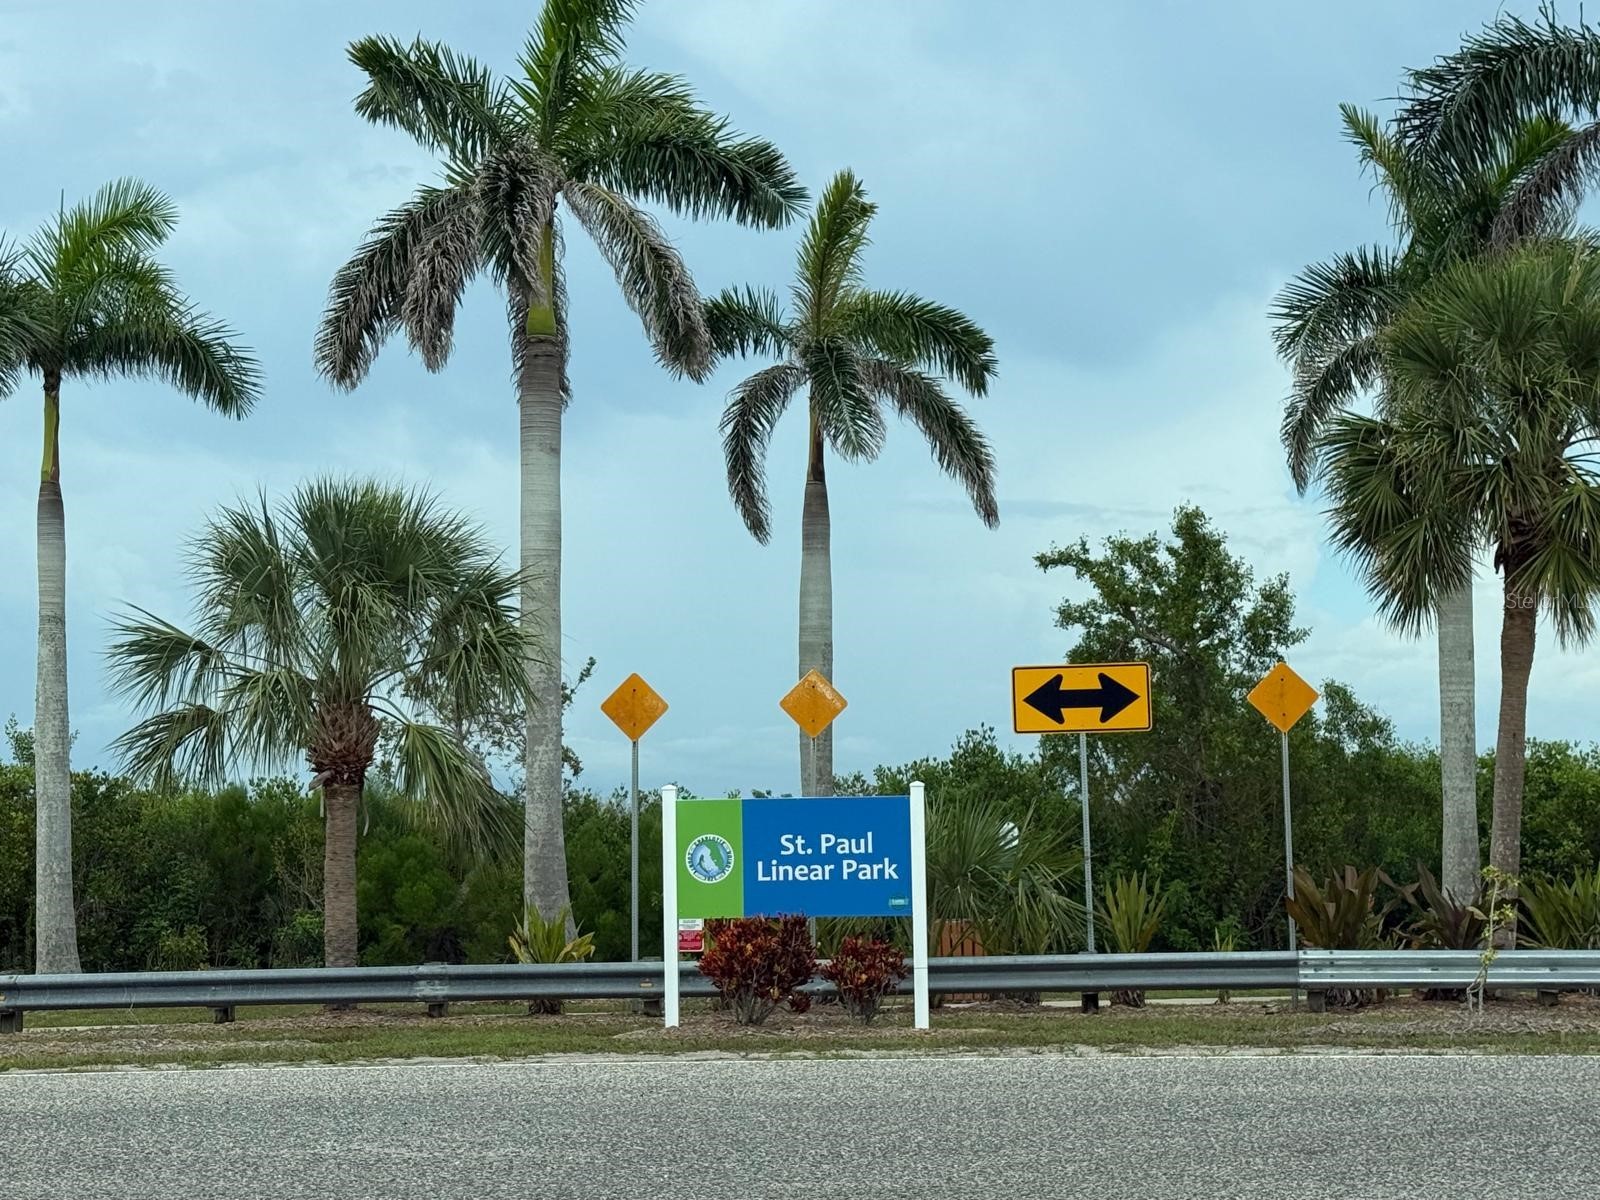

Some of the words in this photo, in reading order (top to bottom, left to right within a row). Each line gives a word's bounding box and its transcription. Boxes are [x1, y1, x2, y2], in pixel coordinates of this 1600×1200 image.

[780, 834, 813, 855] St.
[820, 831, 873, 855] Paul
[757, 859, 835, 881] Linear
[842, 857, 899, 880] Park
